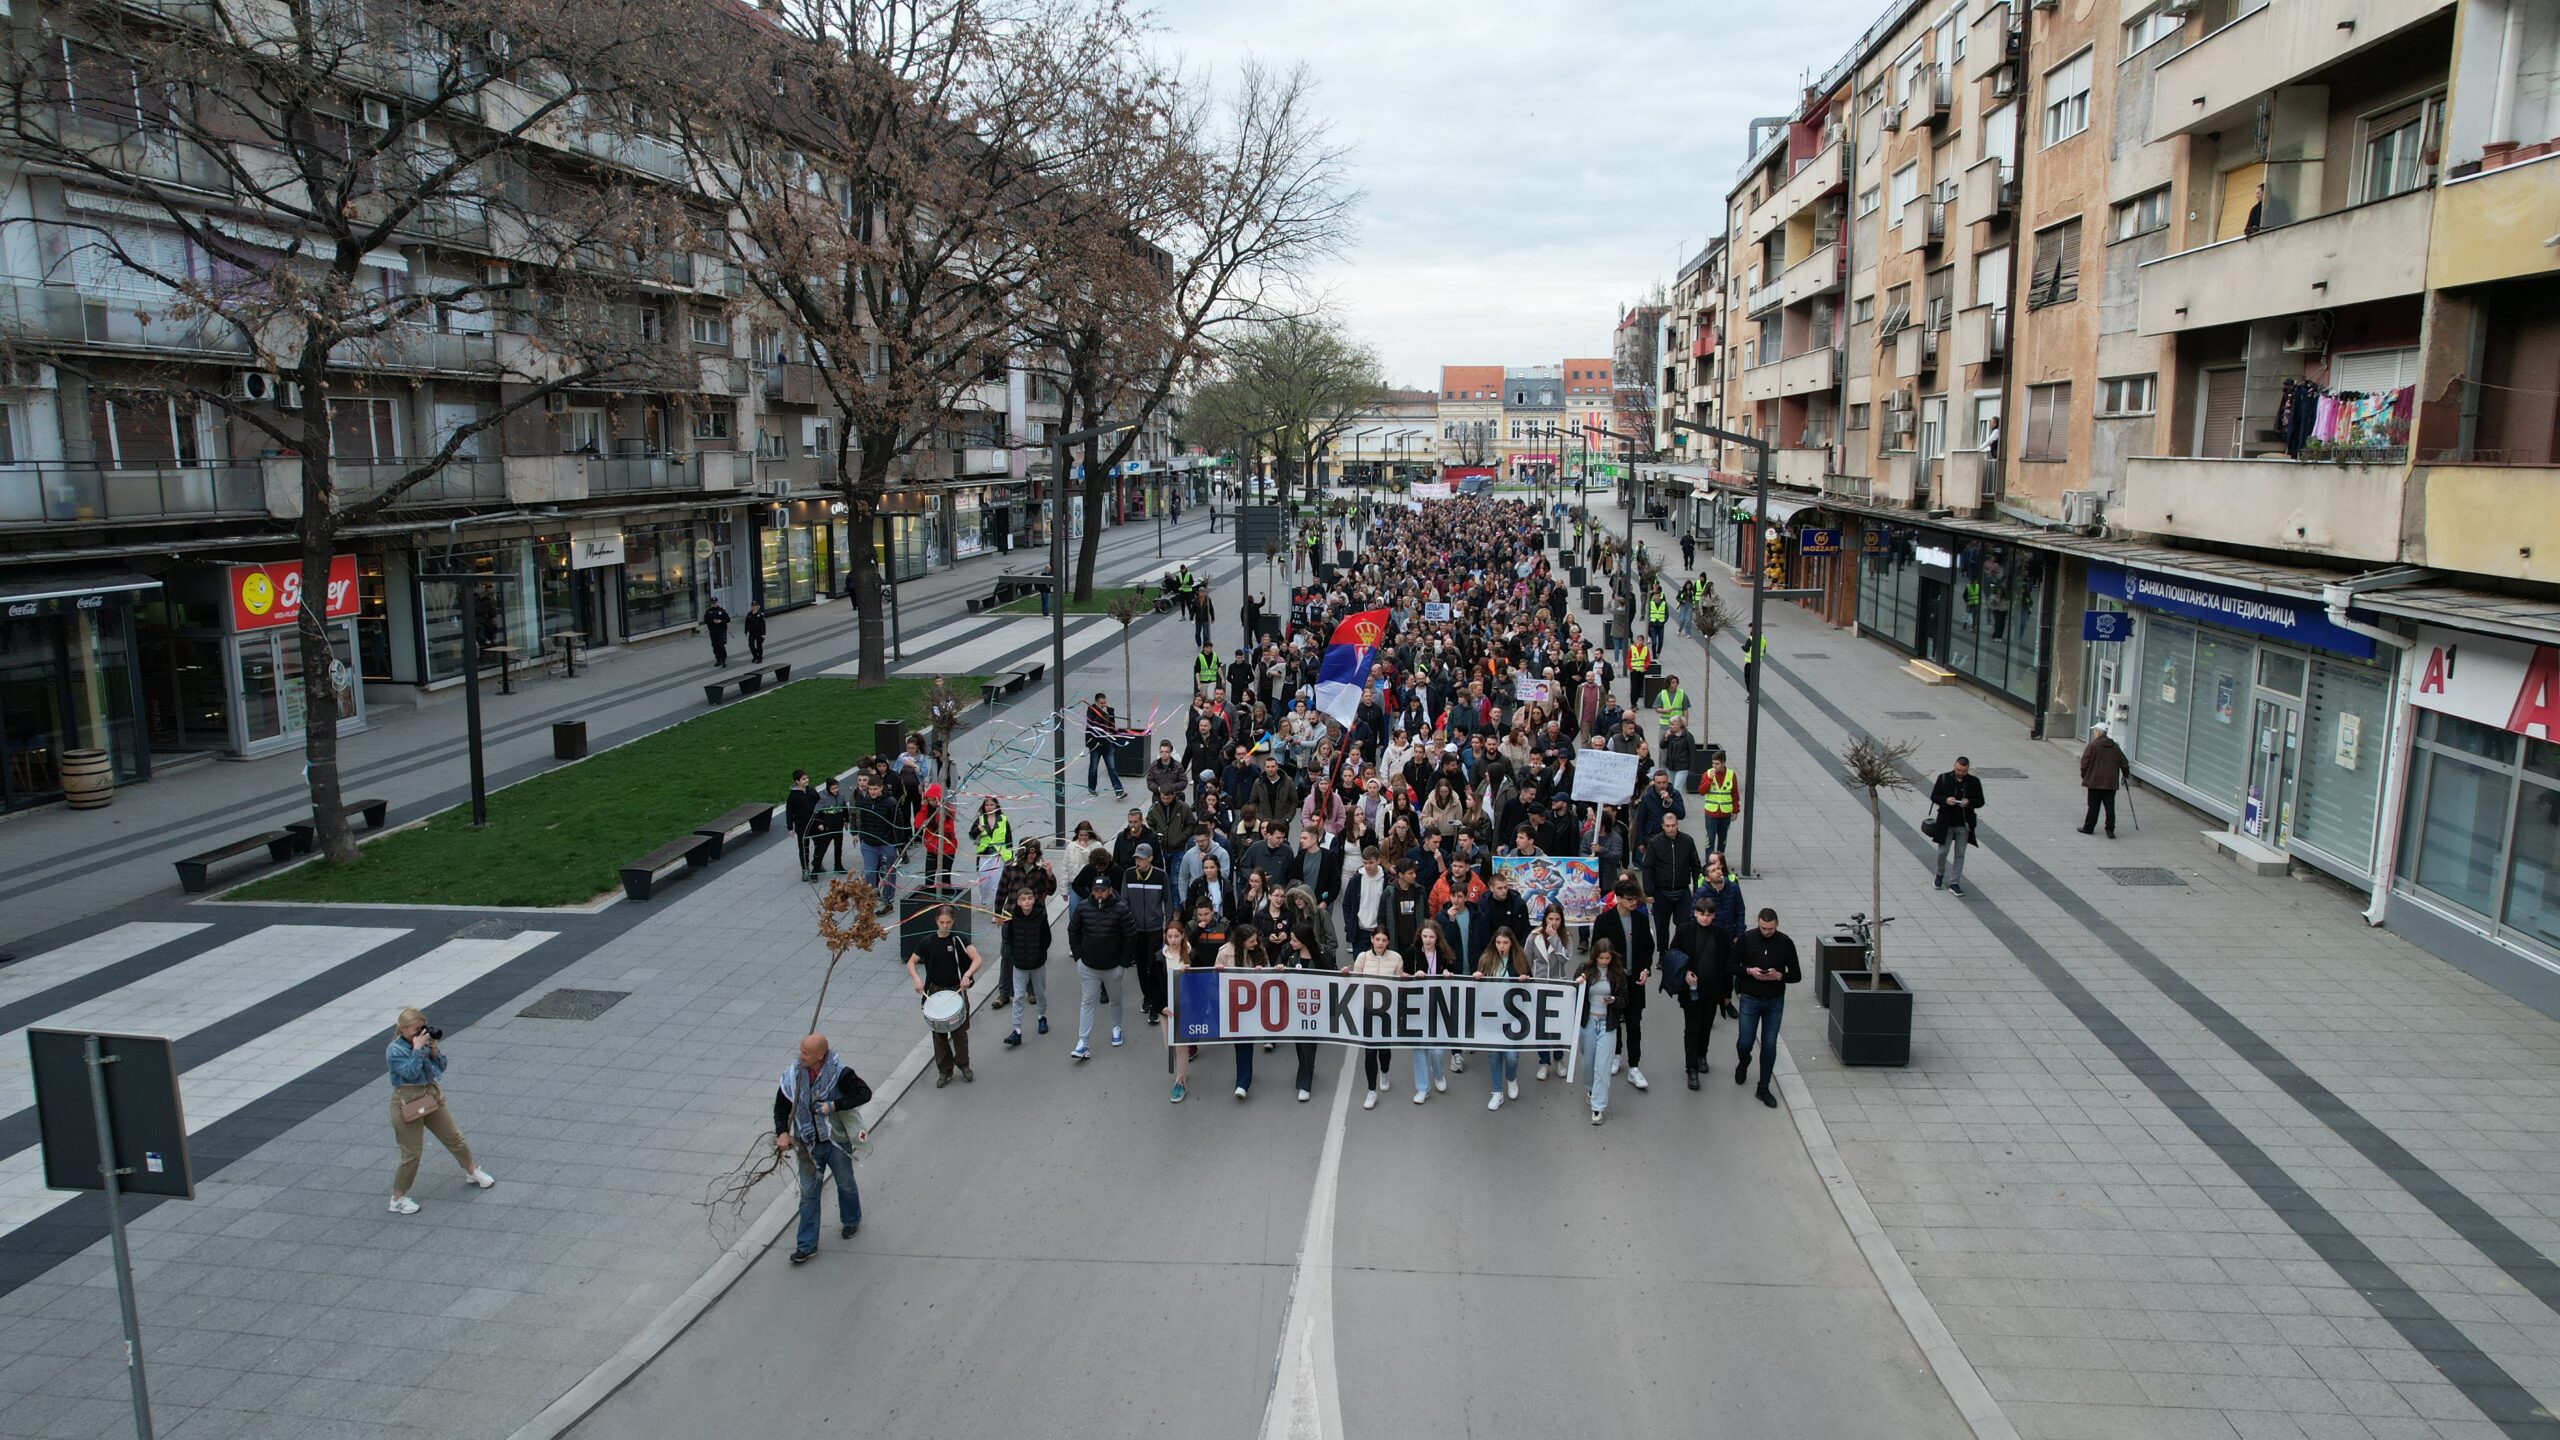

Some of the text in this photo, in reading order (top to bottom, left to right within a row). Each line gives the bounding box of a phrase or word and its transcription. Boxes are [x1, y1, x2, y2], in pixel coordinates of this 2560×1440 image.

[2138, 579, 2296, 629] БАНКА ПОШТАНСКА ШТЕДИОНИЦА
[2420, 644, 2457, 694] A1
[1188, 1024, 1209, 1035] SRB
[1228, 979, 1564, 1041] PO KRENI-SE
